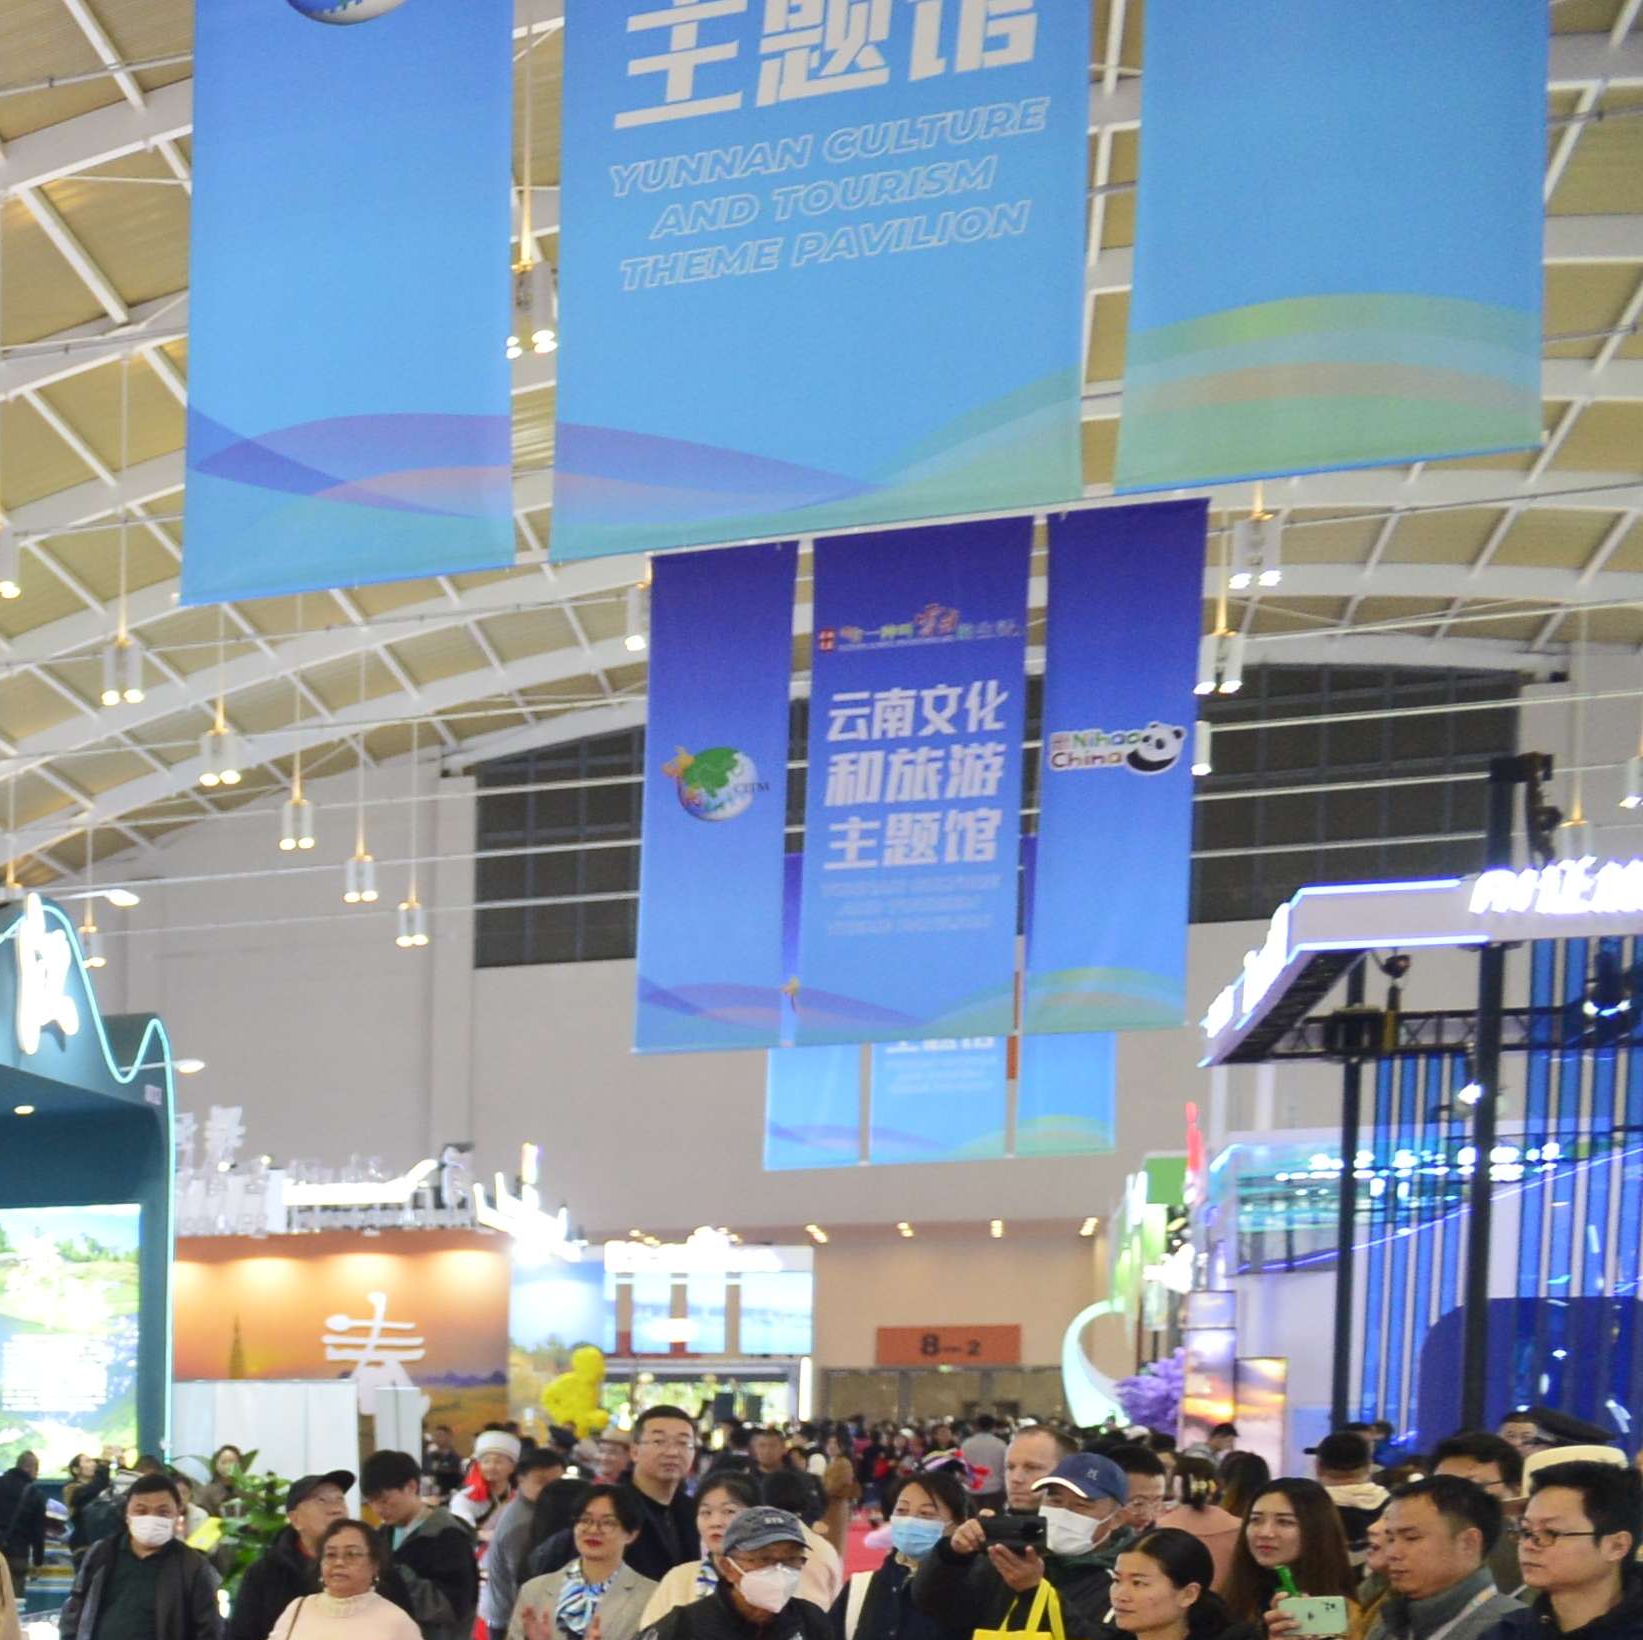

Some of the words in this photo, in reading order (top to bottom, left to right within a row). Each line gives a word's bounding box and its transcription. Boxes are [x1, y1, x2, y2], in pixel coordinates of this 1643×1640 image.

[609, 135, 813, 197] YUNNAN
[822, 97, 1051, 164] CULTURE
[649, 193, 761, 241] AND
[775, 154, 999, 224] TOURISM
[619, 237, 782, 292] THEME
[791, 199, 1033, 268] PAVILION
[826, 679, 1010, 743] 云南文化
[823, 741, 1007, 807] 和旅游
[1050, 750, 1123, 768] China
[822, 807, 1004, 870] 主题馆
